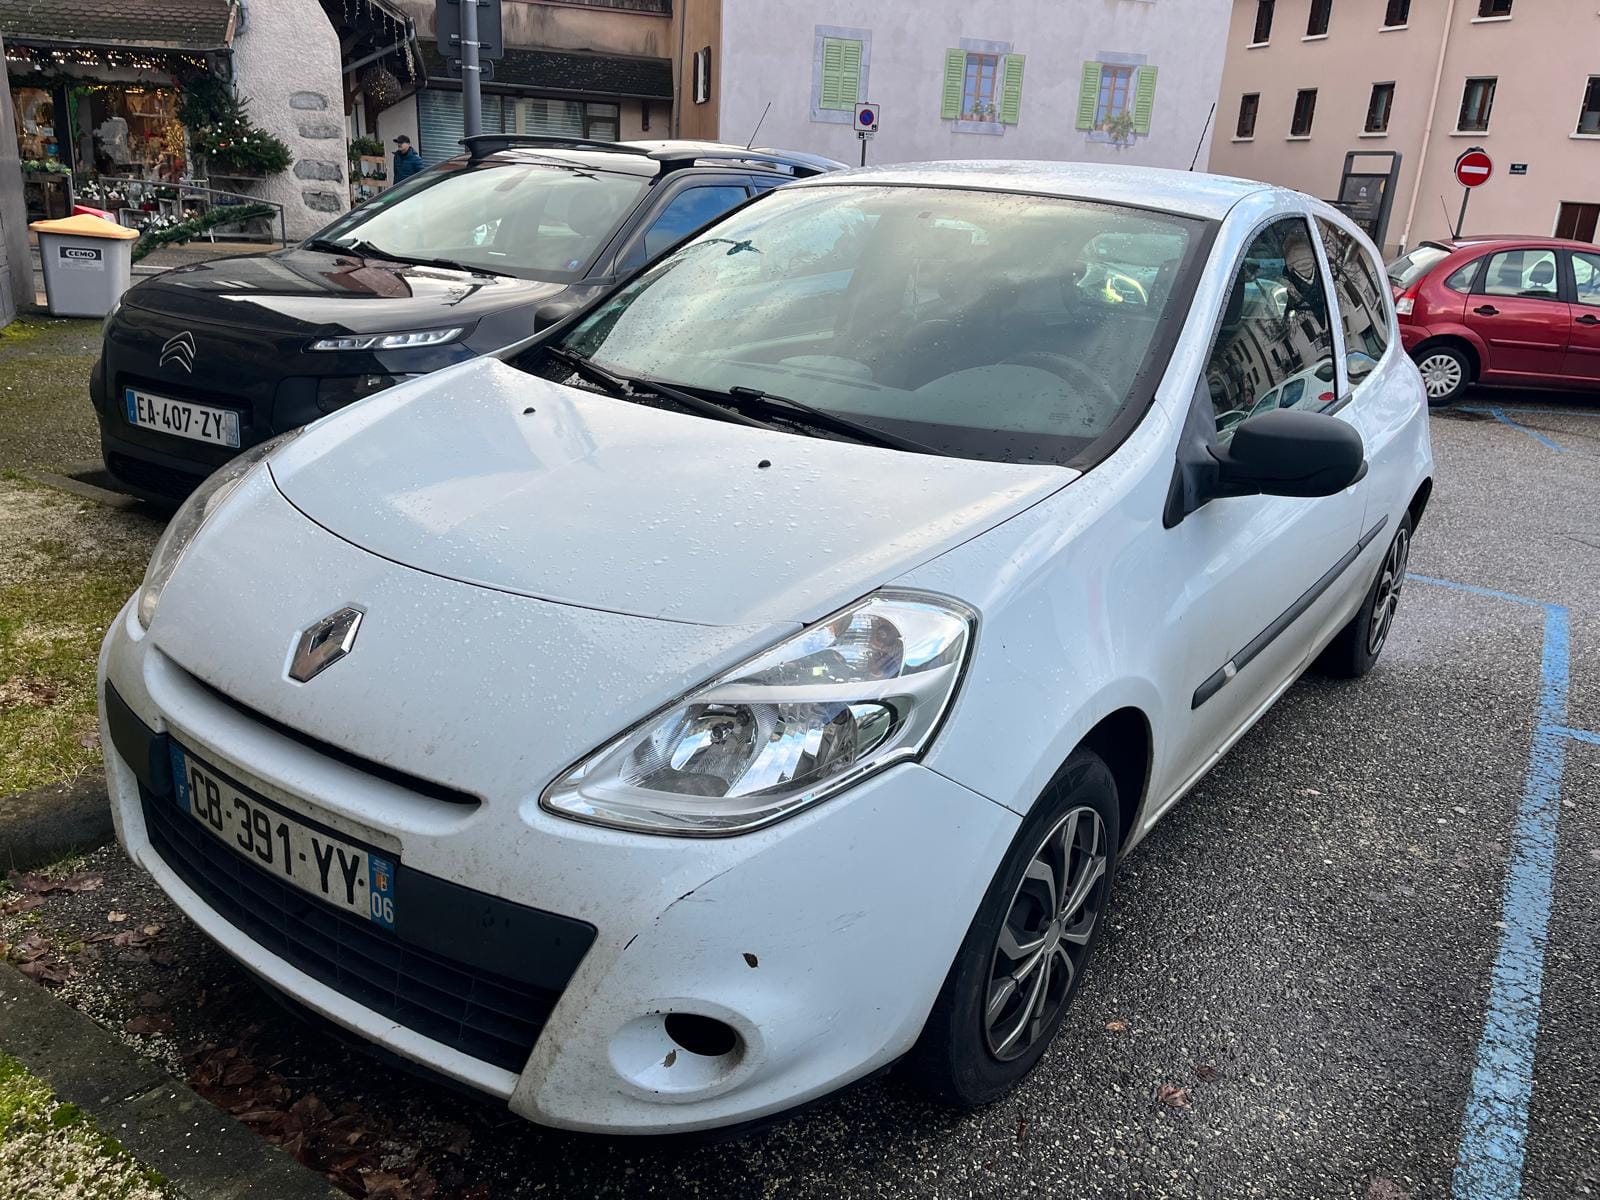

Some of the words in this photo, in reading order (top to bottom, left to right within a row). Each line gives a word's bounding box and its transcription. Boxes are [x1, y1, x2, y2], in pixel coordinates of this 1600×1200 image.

[136, 396, 222, 440] EA-407-ZY
[190, 766, 360, 905] CB-391-YY
[371, 891, 394, 924] 06
